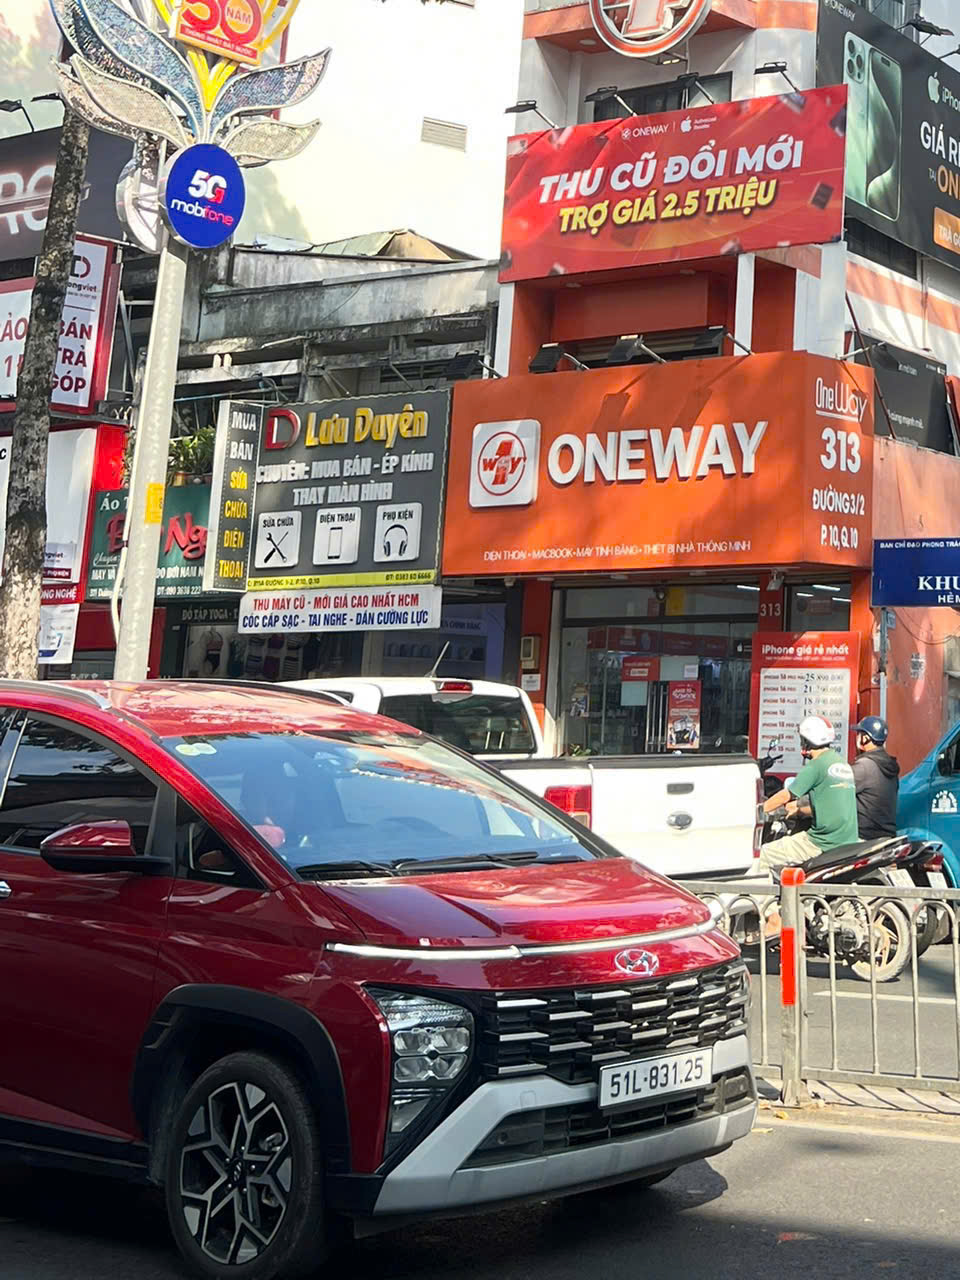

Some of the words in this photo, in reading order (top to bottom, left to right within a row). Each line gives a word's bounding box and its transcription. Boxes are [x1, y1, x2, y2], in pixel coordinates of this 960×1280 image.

[632, 123, 669, 138] ONEWAY
[920, 121, 946, 160] GIÁ
[539, 167, 604, 204] THU
[609, 151, 658, 191] CŨ
[663, 139, 727, 184] ĐỔI
[735, 133, 804, 175] MỚI
[187, 169, 227, 204] 5G
[170, 198, 234, 227] mobifone
[559, 199, 609, 236] TRỢ
[612, 189, 656, 225] GIÁ
[660, 190, 700, 219] 2.5
[704, 175, 778, 216] TRIỆU
[231, 411, 257, 432] MUA
[353, 403, 429, 450] Duyên
[229, 438, 254, 462] BÁN
[548, 421, 769, 486] ONEWAY
[820, 426, 862, 473] 313
[310, 459, 341, 480] MUA
[342, 454, 373, 478] BÁN
[380, 452, 400, 475] ÉP
[400, 450, 435, 473] KÍNH
[100, 492, 120, 511] Áo
[292, 487, 327, 507] THAY
[361, 479, 394, 501] HÌNH
[531, 548, 573, 560] MACBOOK
[728, 540, 751, 552] MINH
[921, 541, 945, 549] PHONG
[56, 585, 77, 601] NGHỆ
[253, 598, 270, 611] THU
[333, 593, 348, 609] GIÁ
[350, 595, 369, 609] CAO
[371, 591, 396, 608] NHẤT
[397, 593, 419, 607] HCM
[261, 612, 280, 628] CÁP
[281, 613, 300, 629] SẠC
[308, 613, 321, 627] TAI
[323, 612, 347, 626] NGHE
[355, 610, 375, 626] DÁN
[410, 610, 429, 627] LỰC
[759, 603, 781, 617] 313
[761, 644, 795, 655] iPhone
[825, 642, 849, 655] nhất
